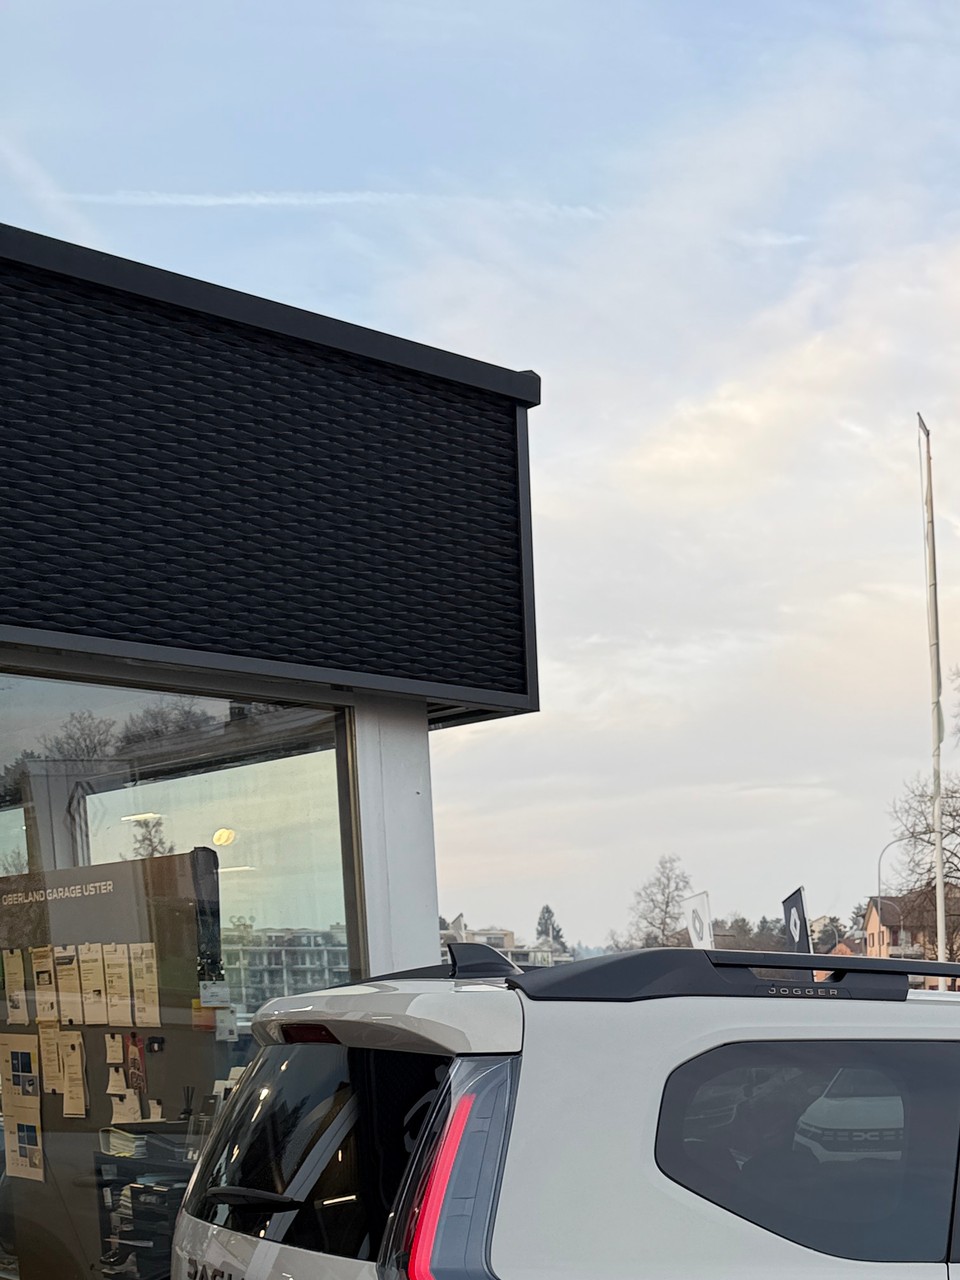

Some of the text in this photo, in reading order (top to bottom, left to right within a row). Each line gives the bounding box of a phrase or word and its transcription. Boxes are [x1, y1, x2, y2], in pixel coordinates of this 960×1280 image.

[2, 880, 113, 905] OBERLAND GARAGE USTER
[768, 987, 838, 996] JOGGER
